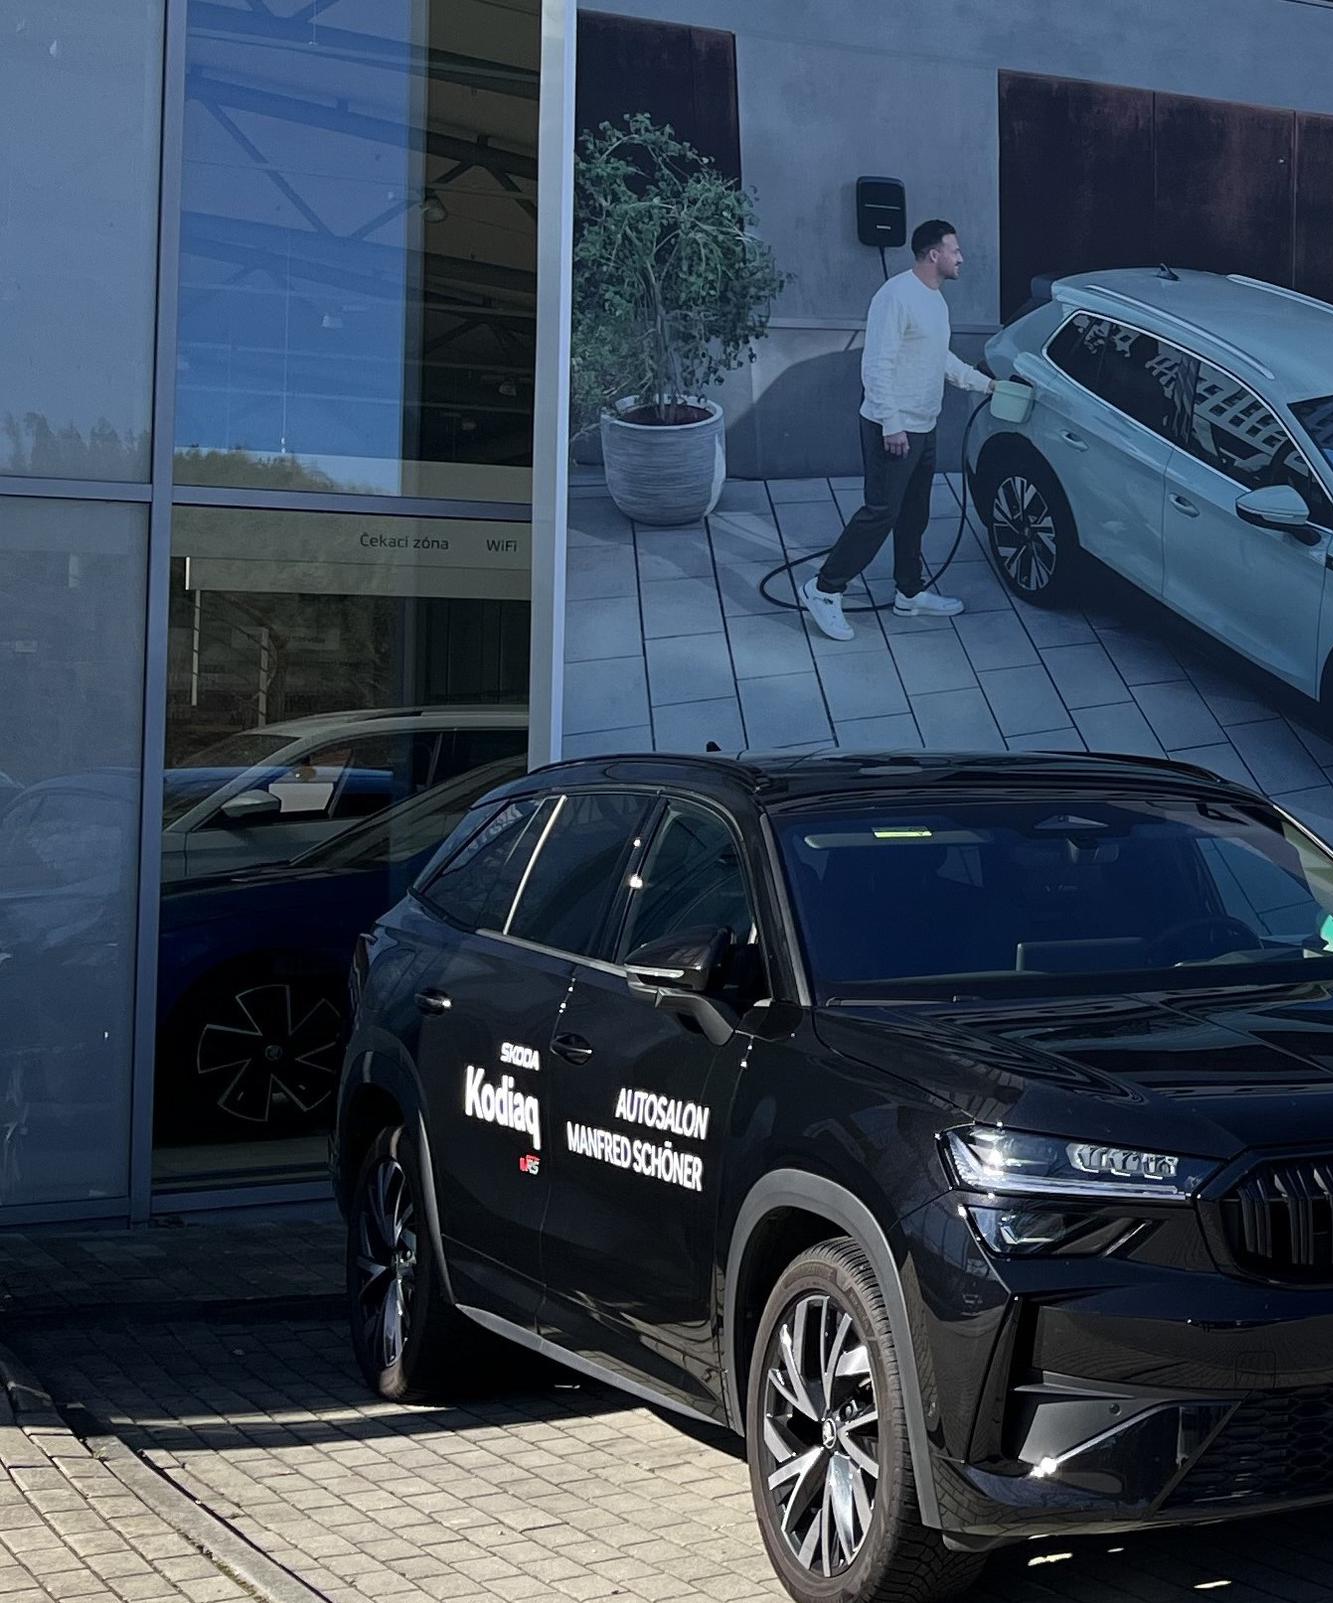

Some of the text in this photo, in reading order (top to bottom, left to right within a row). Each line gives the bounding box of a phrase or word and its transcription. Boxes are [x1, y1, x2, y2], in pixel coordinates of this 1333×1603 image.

[360, 531, 449, 550] Čekací zóna
[486, 538, 518, 552] WiFi
[464, 1064, 541, 1151] Kodiaq
[614, 1087, 710, 1140] AUTOSALON
[566, 1120, 704, 1192] MANFRED SCHÖNER
